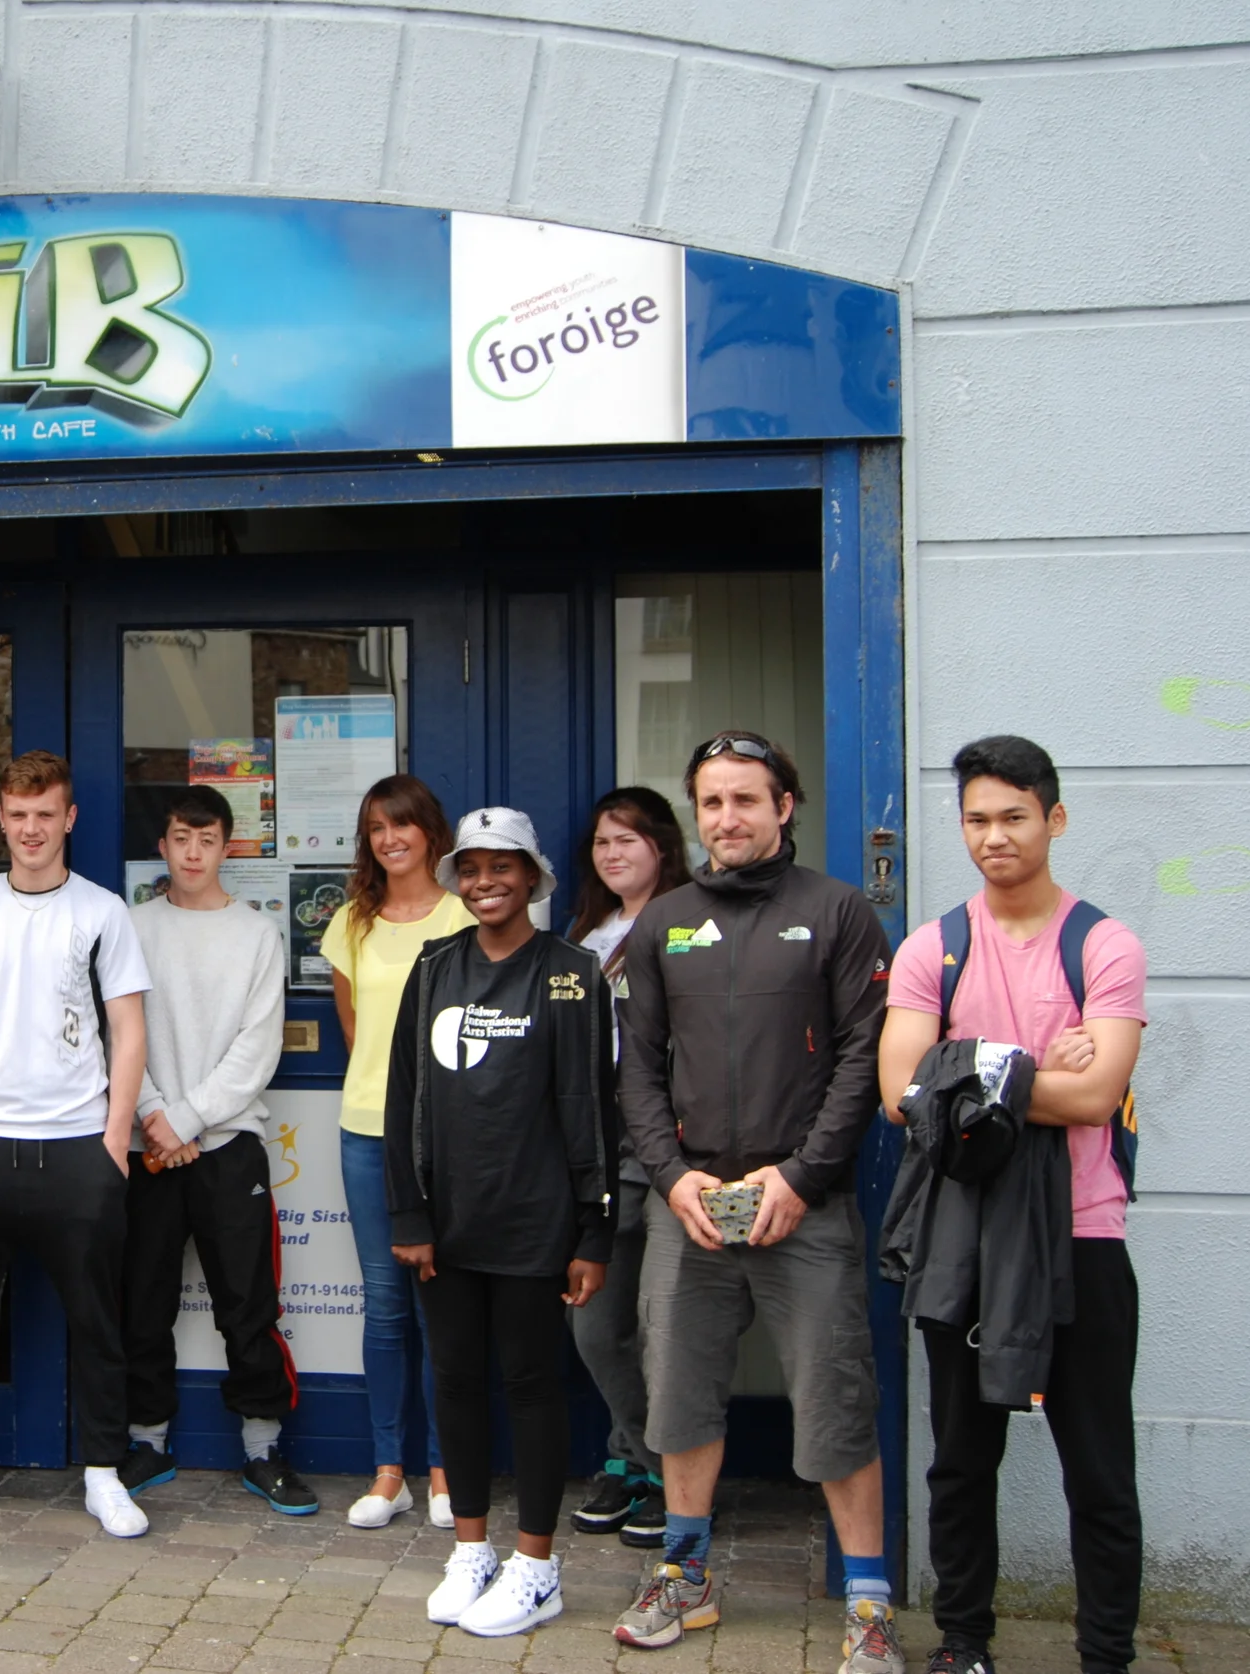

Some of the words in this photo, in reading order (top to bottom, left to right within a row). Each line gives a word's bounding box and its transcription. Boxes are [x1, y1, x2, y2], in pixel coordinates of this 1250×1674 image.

[510, 283, 569, 312] empowering
[568, 271, 596, 292] youth
[514, 299, 559, 324] enriching
[558, 276, 618, 306] communities
[488, 295, 660, 383] foróige
[33, 419, 97, 439] CAFE
[465, 1003, 503, 1019] Galway
[463, 1014, 531, 1027] International
[461, 1024, 485, 1038] Arts
[486, 1025, 526, 1037] Festival
[277, 1209, 305, 1225] Big
